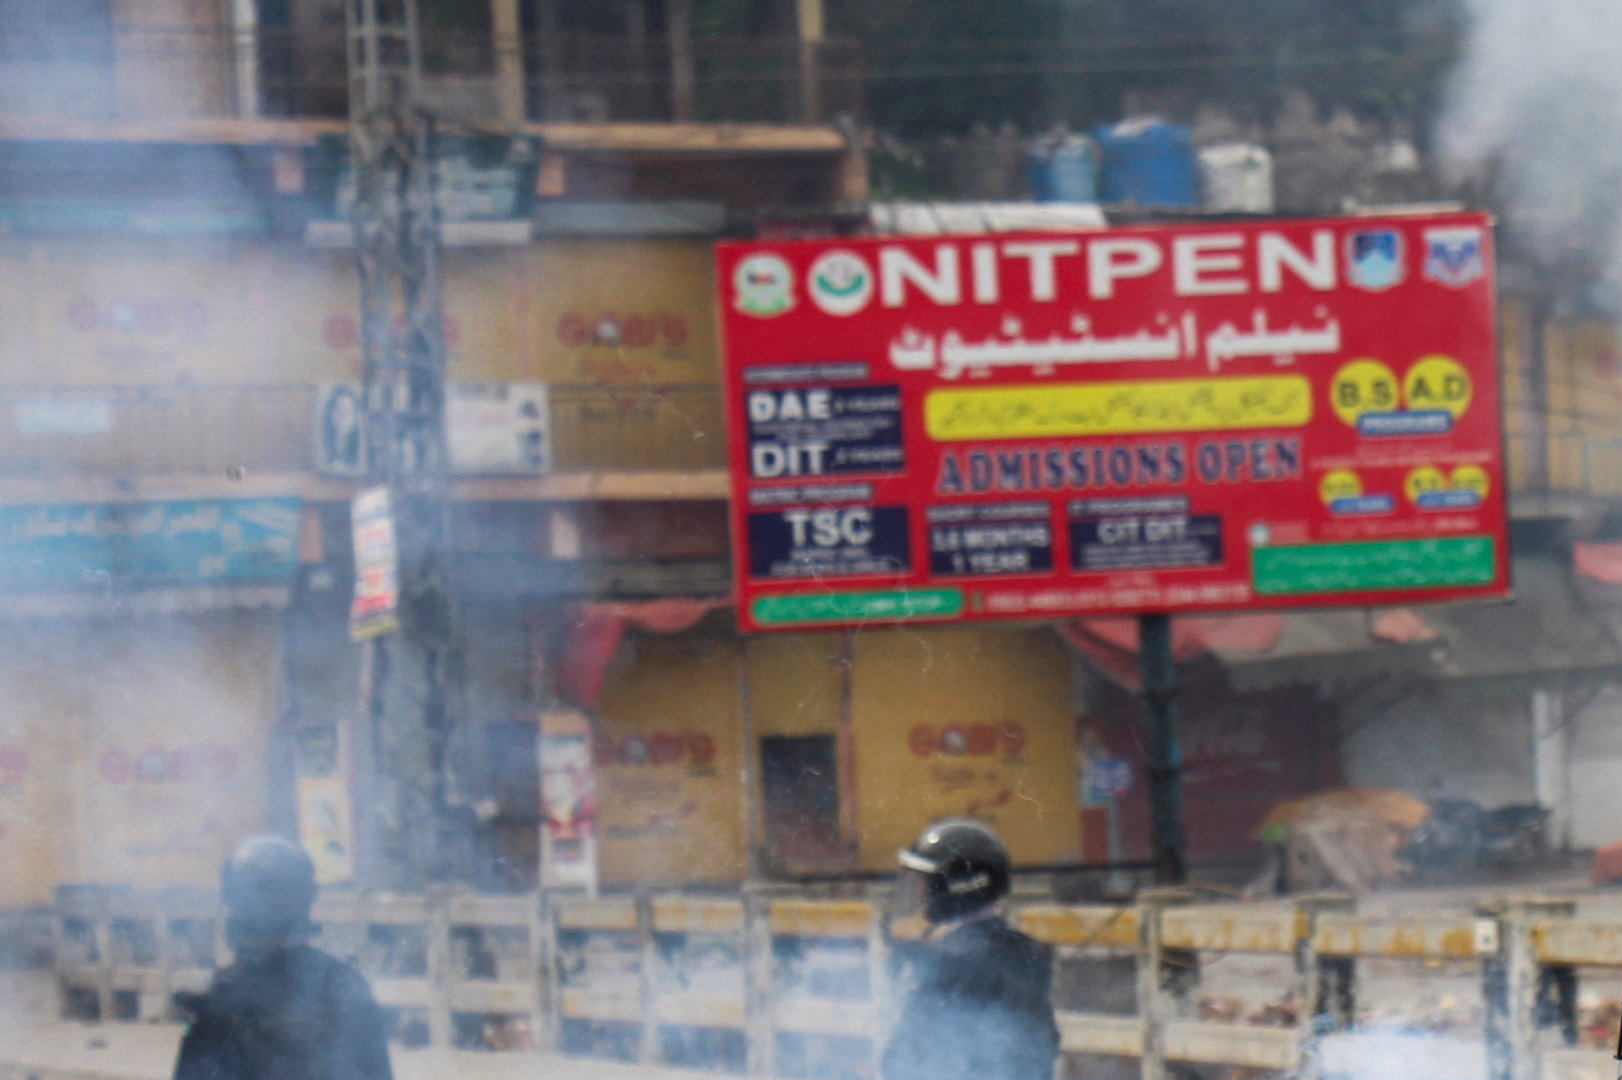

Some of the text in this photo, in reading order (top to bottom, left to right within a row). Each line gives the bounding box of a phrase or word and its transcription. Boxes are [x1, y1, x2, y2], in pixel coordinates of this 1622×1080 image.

[880, 231, 1336, 307] NITPEN
[750, 390, 831, 422] DAE
[753, 443, 829, 477] DIT
[939, 447, 1185, 494] ADMISSIONS
[1201, 440, 1299, 481] OPEN
[784, 510, 873, 547] TSC
